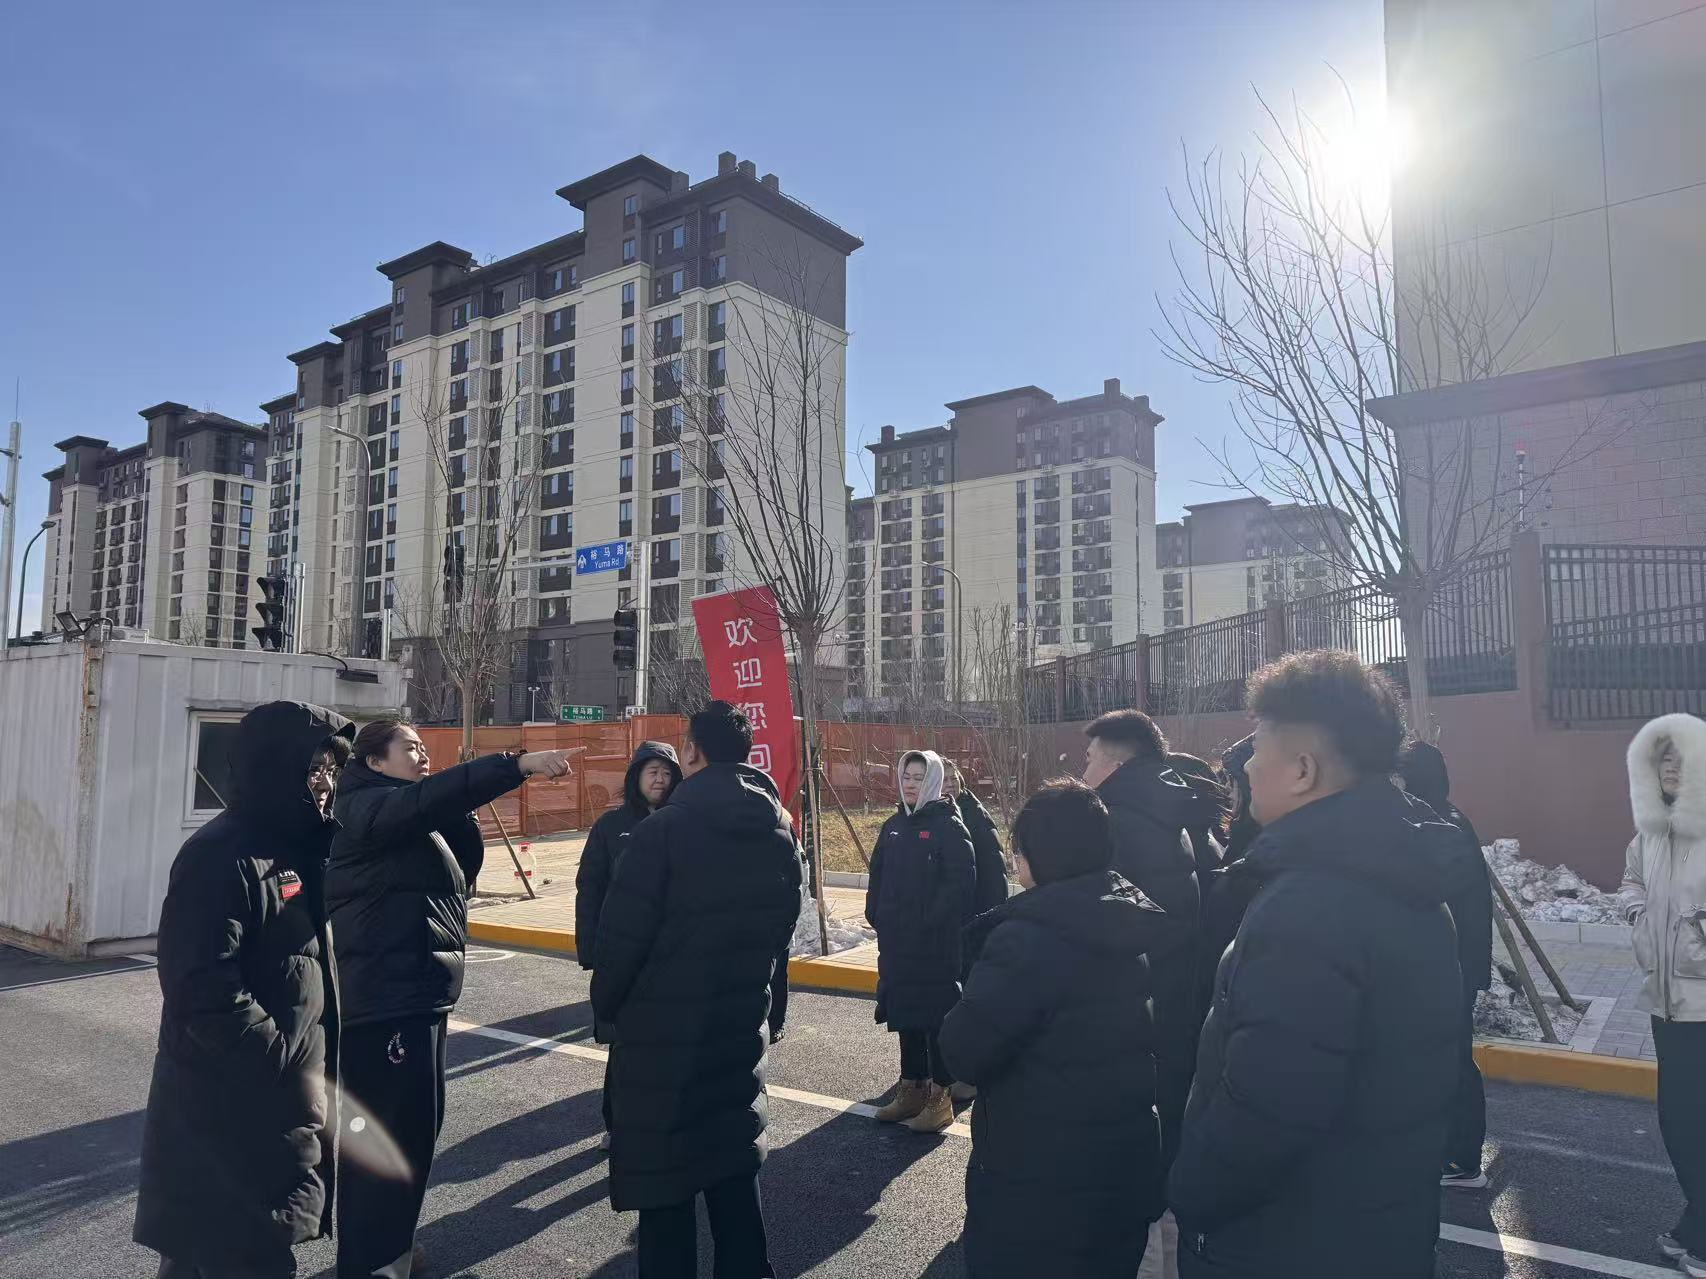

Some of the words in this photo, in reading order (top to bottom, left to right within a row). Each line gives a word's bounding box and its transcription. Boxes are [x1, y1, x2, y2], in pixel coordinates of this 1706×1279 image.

[590, 544, 624, 560] 裕马路
[594, 560, 611, 569] Yuma
[611, 557, 620, 567] Rd
